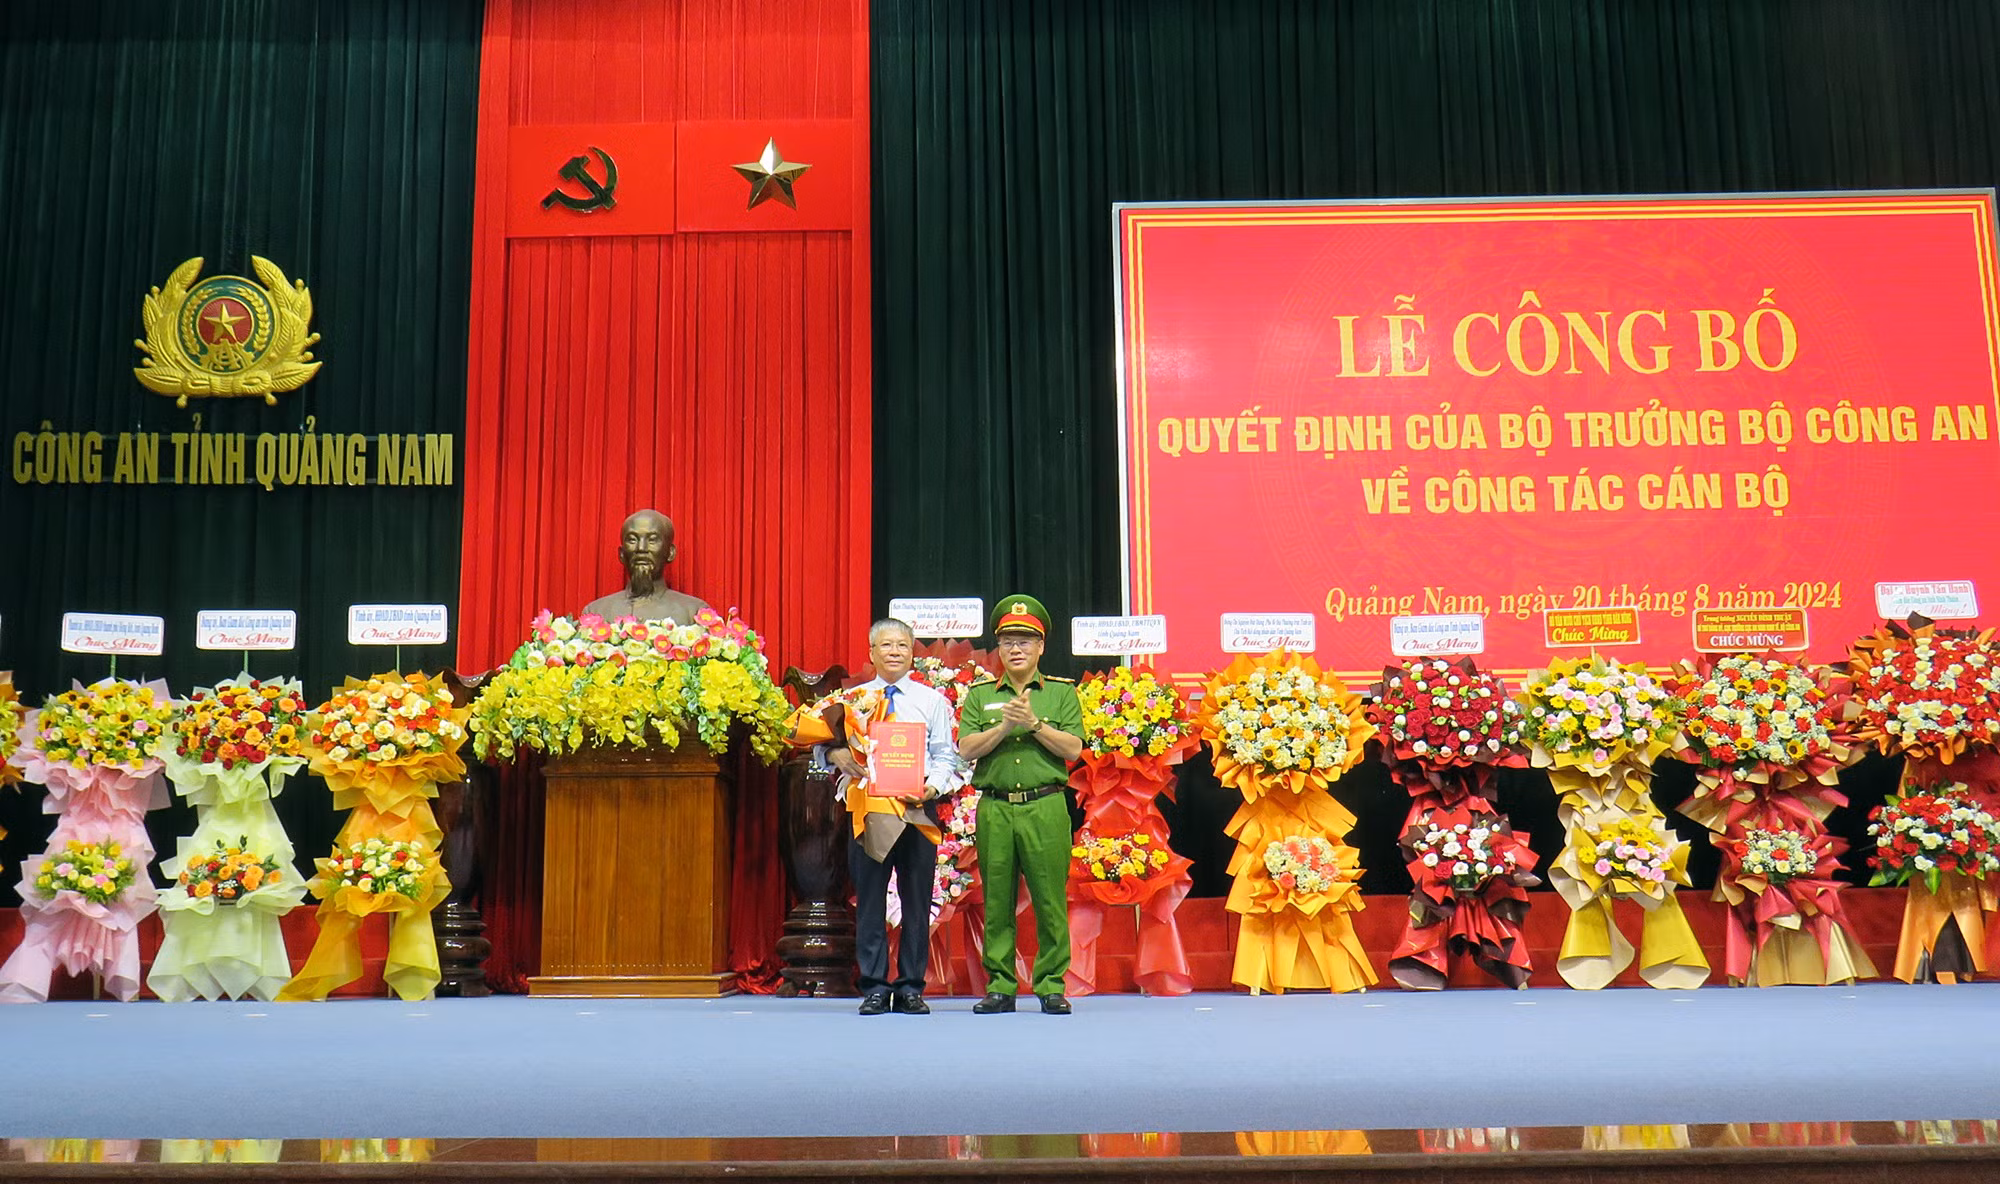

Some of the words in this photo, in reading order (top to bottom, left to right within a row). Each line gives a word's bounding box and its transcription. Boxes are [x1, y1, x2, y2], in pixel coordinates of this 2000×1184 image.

[1333, 293, 1430, 378] LỄ
[1453, 290, 1672, 377] CÔNG
[1690, 288, 1798, 373] BỐ
[13, 420, 102, 484] CÔNG
[113, 433, 159, 484] AN
[171, 413, 245, 484] TỈNH
[255, 415, 367, 491] QUẢNG
[378, 434, 453, 485] NAM
[1157, 405, 1281, 454] QUYẾT
[1294, 416, 1391, 459] ĐỊNH
[1405, 402, 1487, 451] CỦA
[1500, 405, 1553, 457] BỘ
[1564, 398, 1725, 448] TRƯỞNG
[1739, 401, 1792, 453] BỘ
[1805, 400, 1917, 444] CÔNG
[1931, 405, 1988, 441] AN
[1362, 466, 1412, 515] VỀ
[1424, 468, 1535, 513] CÔNG
[1547, 467, 1625, 512] TÁC
[1637, 465, 1722, 510] CÁN
[1735, 464, 1790, 516] BỘ
[1325, 585, 1416, 622] Quảng
[1421, 587, 1491, 619] Nam,
[1498, 586, 1565, 619] ngày
[1573, 586, 1601, 608] 20
[1609, 584, 1687, 617] tháng
[1694, 584, 1709, 609] 8
[1718, 584, 1775, 609] năm
[1784, 582, 1841, 608] 2024
[1551, 628, 1585, 643] Chúc
[1588, 626, 1630, 643] Mừng
[1710, 633, 1745, 647] CHÚC
[1746, 633, 1784, 647] MỪNG
